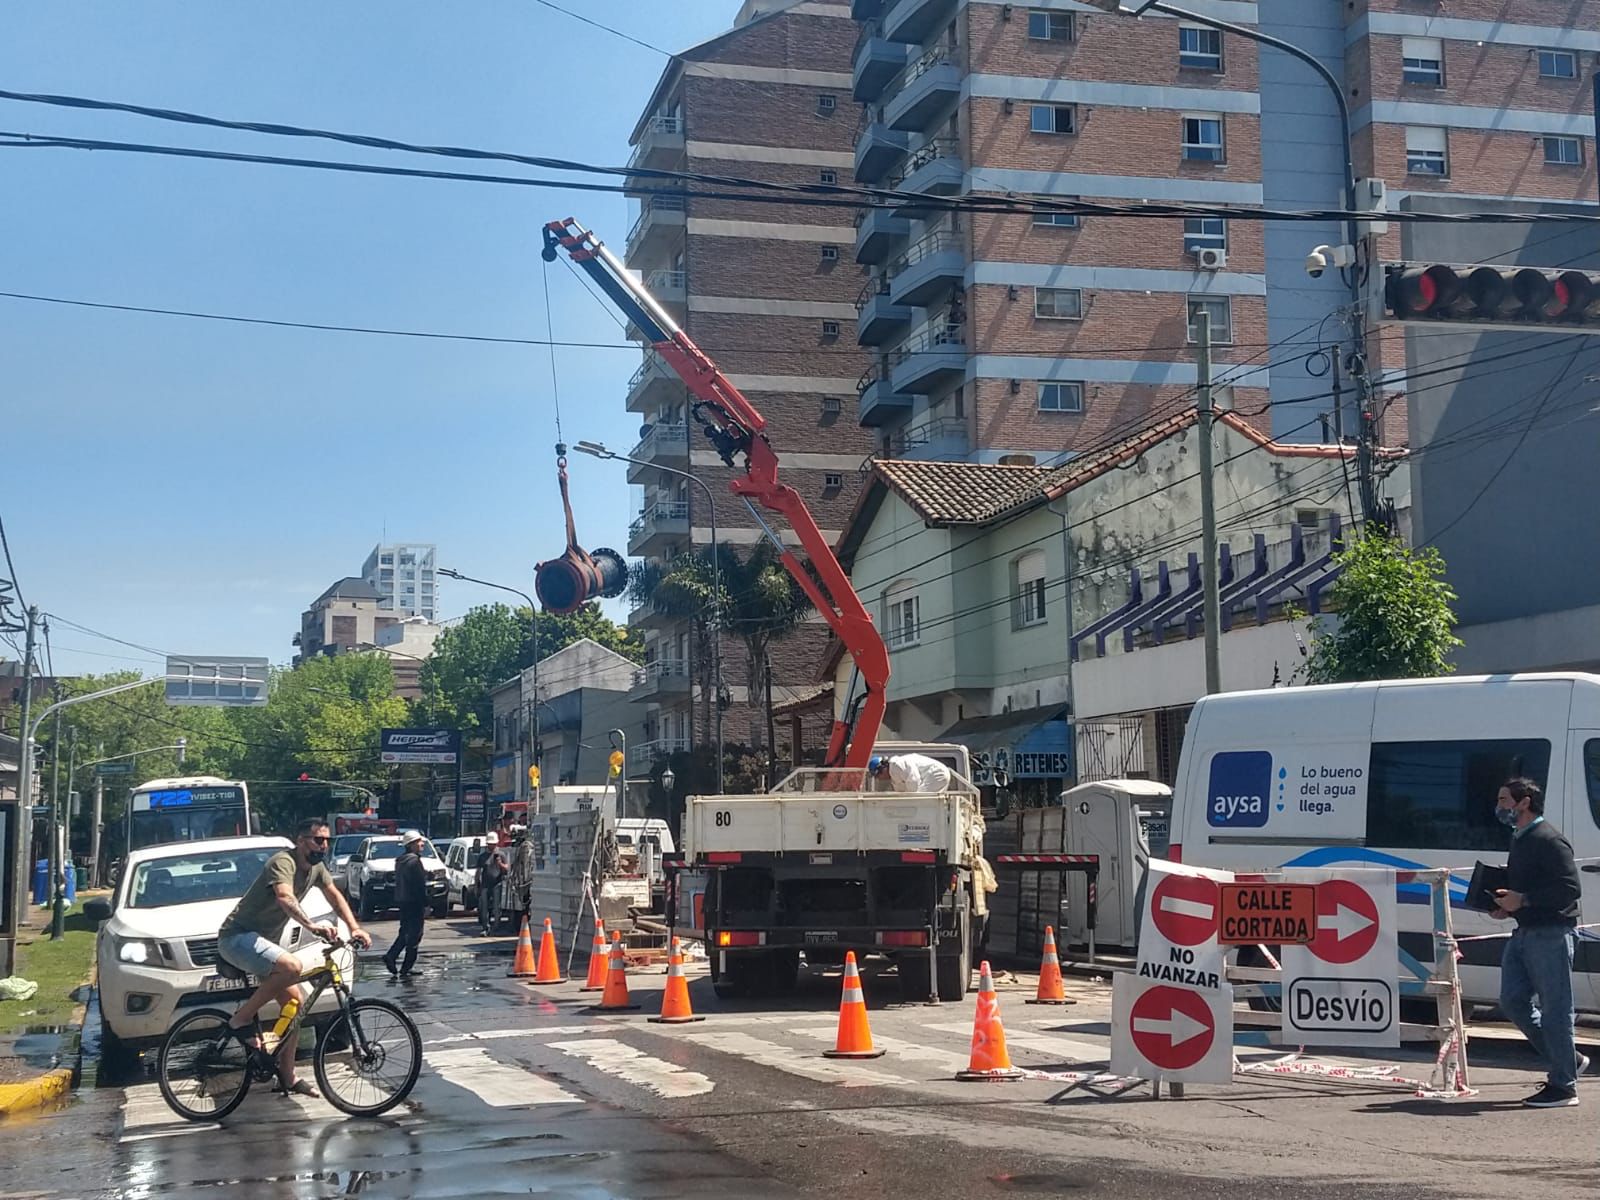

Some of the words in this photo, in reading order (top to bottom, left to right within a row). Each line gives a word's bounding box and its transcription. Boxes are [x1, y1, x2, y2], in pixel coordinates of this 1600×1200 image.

[1015, 753, 1068, 774] RETENES
[1301, 766, 1317, 778] Lo
[1320, 766, 1363, 778] bueno
[1300, 783, 1320, 795] del
[1323, 785, 1356, 798] agua
[1214, 795, 1262, 819] aysa
[1299, 800, 1335, 815] llega.
[715, 811, 731, 827] 80
[1237, 890, 1292, 910] CALLE
[1225, 917, 1309, 938] CORTADA
[1169, 947, 1194, 965] NO
[1139, 962, 1220, 990] AVANZAR
[1296, 989, 1384, 1022] Desvío
